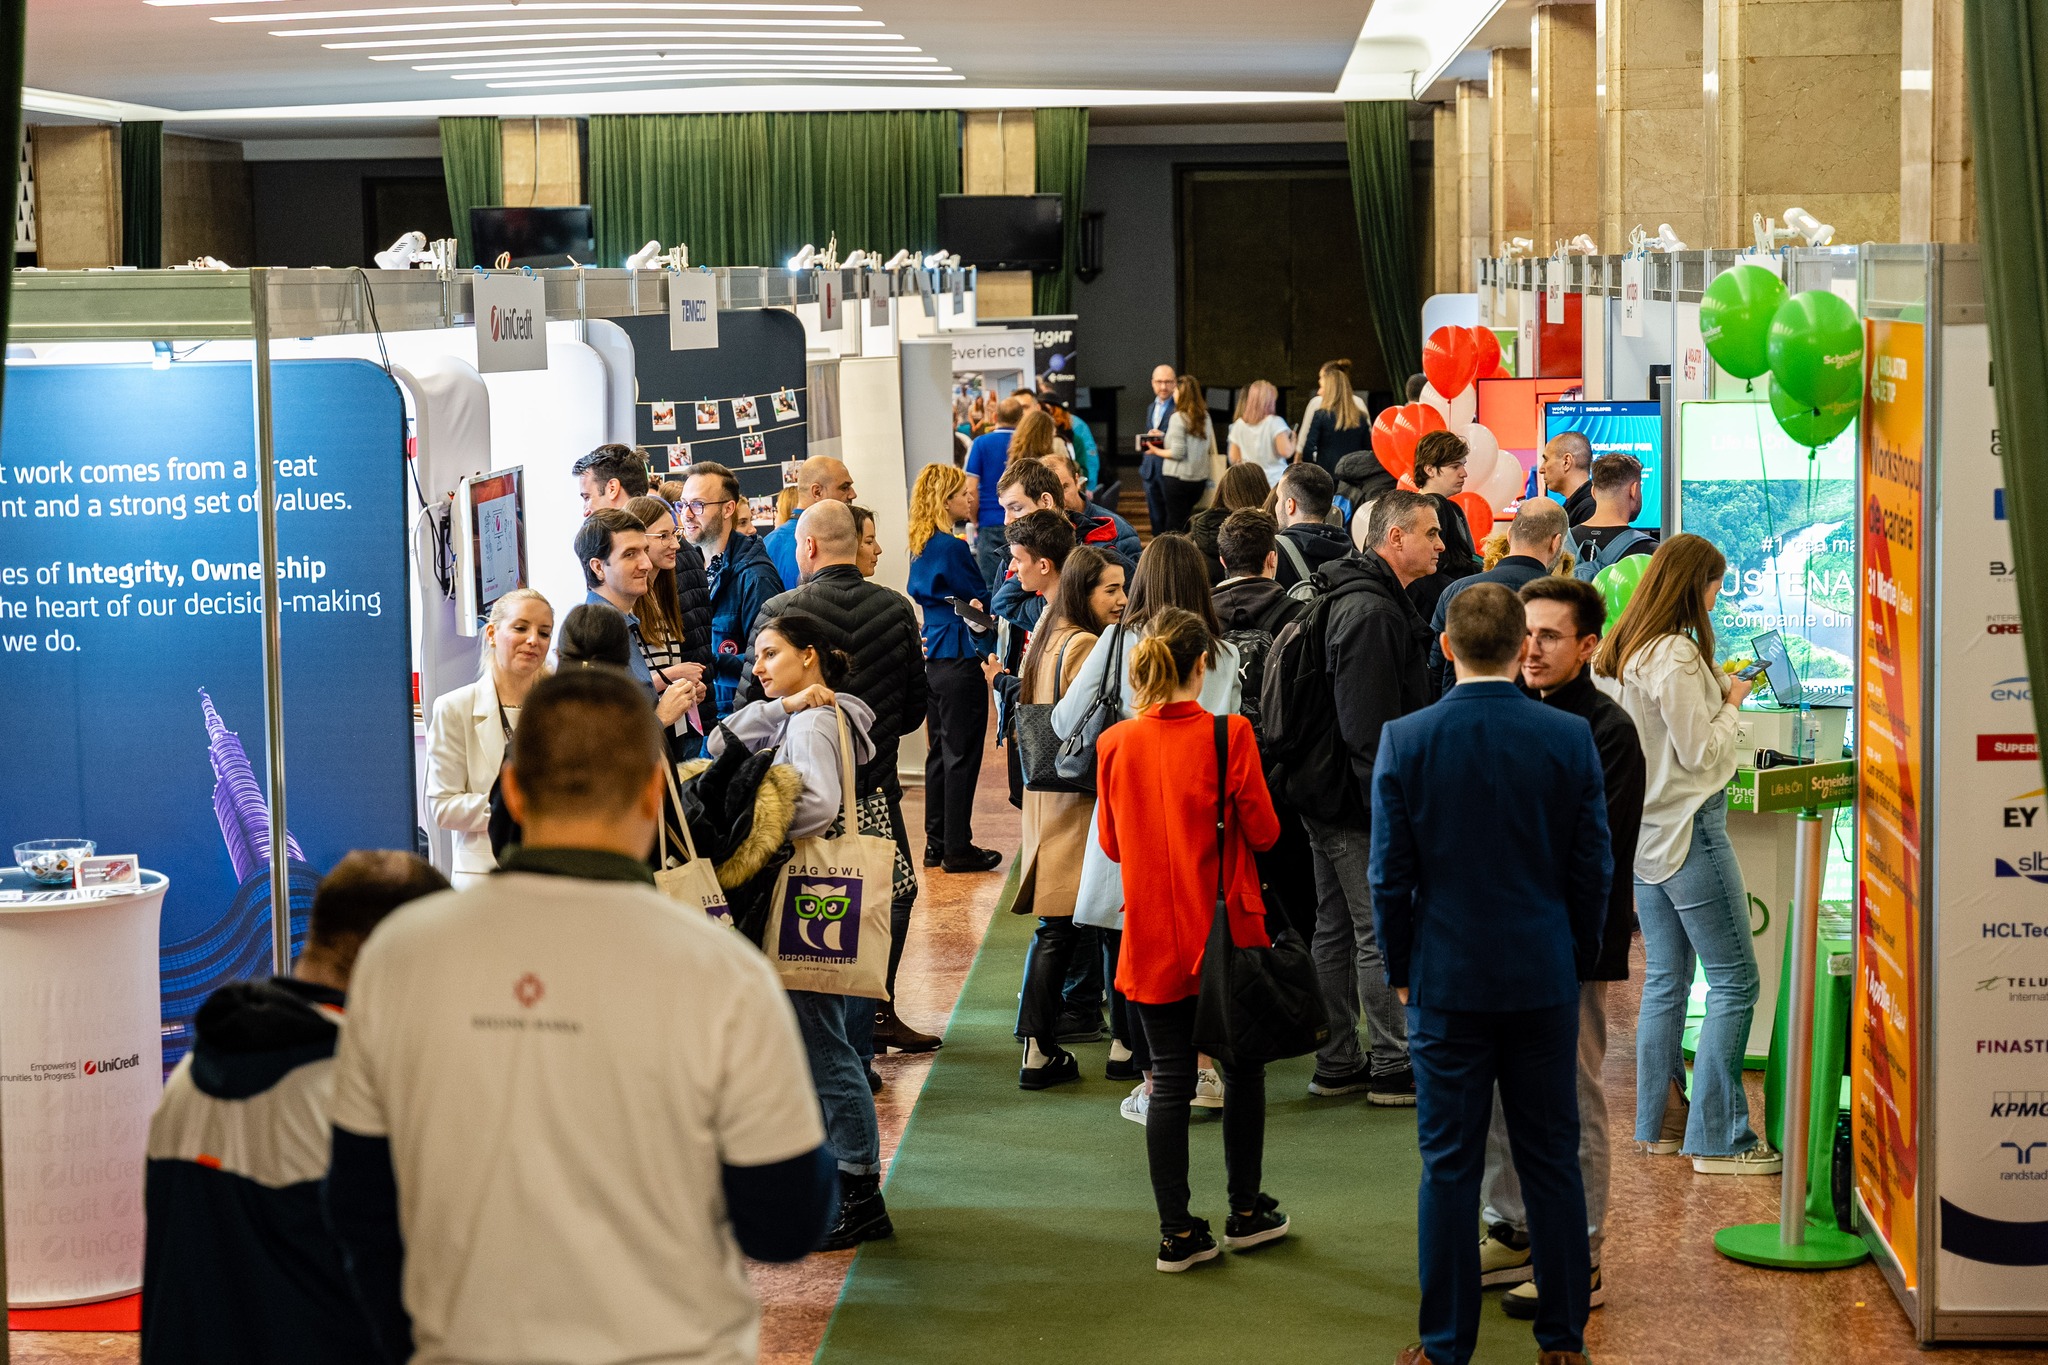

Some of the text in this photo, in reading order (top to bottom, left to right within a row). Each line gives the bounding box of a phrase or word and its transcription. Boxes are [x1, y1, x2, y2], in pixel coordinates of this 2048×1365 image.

[681, 299, 707, 322] TENNECO
[499, 307, 533, 341] UniCredit
[951, 344, 1025, 361] everience
[14, 460, 73, 484] work
[80, 463, 160, 483] comes
[167, 457, 226, 482] from
[234, 461, 247, 479] a
[256, 455, 318, 478] reat
[34, 493, 79, 517] and
[88, 498, 102, 517] a
[110, 494, 187, 519] strong
[194, 491, 231, 514] set
[1761, 535, 1784, 553] #1
[36, 561, 62, 585] of
[68, 561, 184, 588] Integrity,
[191, 555, 326, 583] Owneship
[36, 595, 100, 618] heart
[107, 593, 132, 617] of
[138, 598, 176, 616] our
[1723, 612, 1817, 634] companie
[2, 628, 81, 652] we do.
[1811, 772, 1856, 791] Schneider
[2003, 806, 2040, 828] EY
[788, 864, 863, 878] BAG OWL
[701, 894, 720, 906] BAG
[778, 953, 857, 965] OPPORTUNITIES
[30, 1061, 77, 1072] Empowering
[97, 1053, 140, 1073] UniCredit
[34, 1073, 42, 1081] to
[43, 1072, 76, 1082] Progress.
